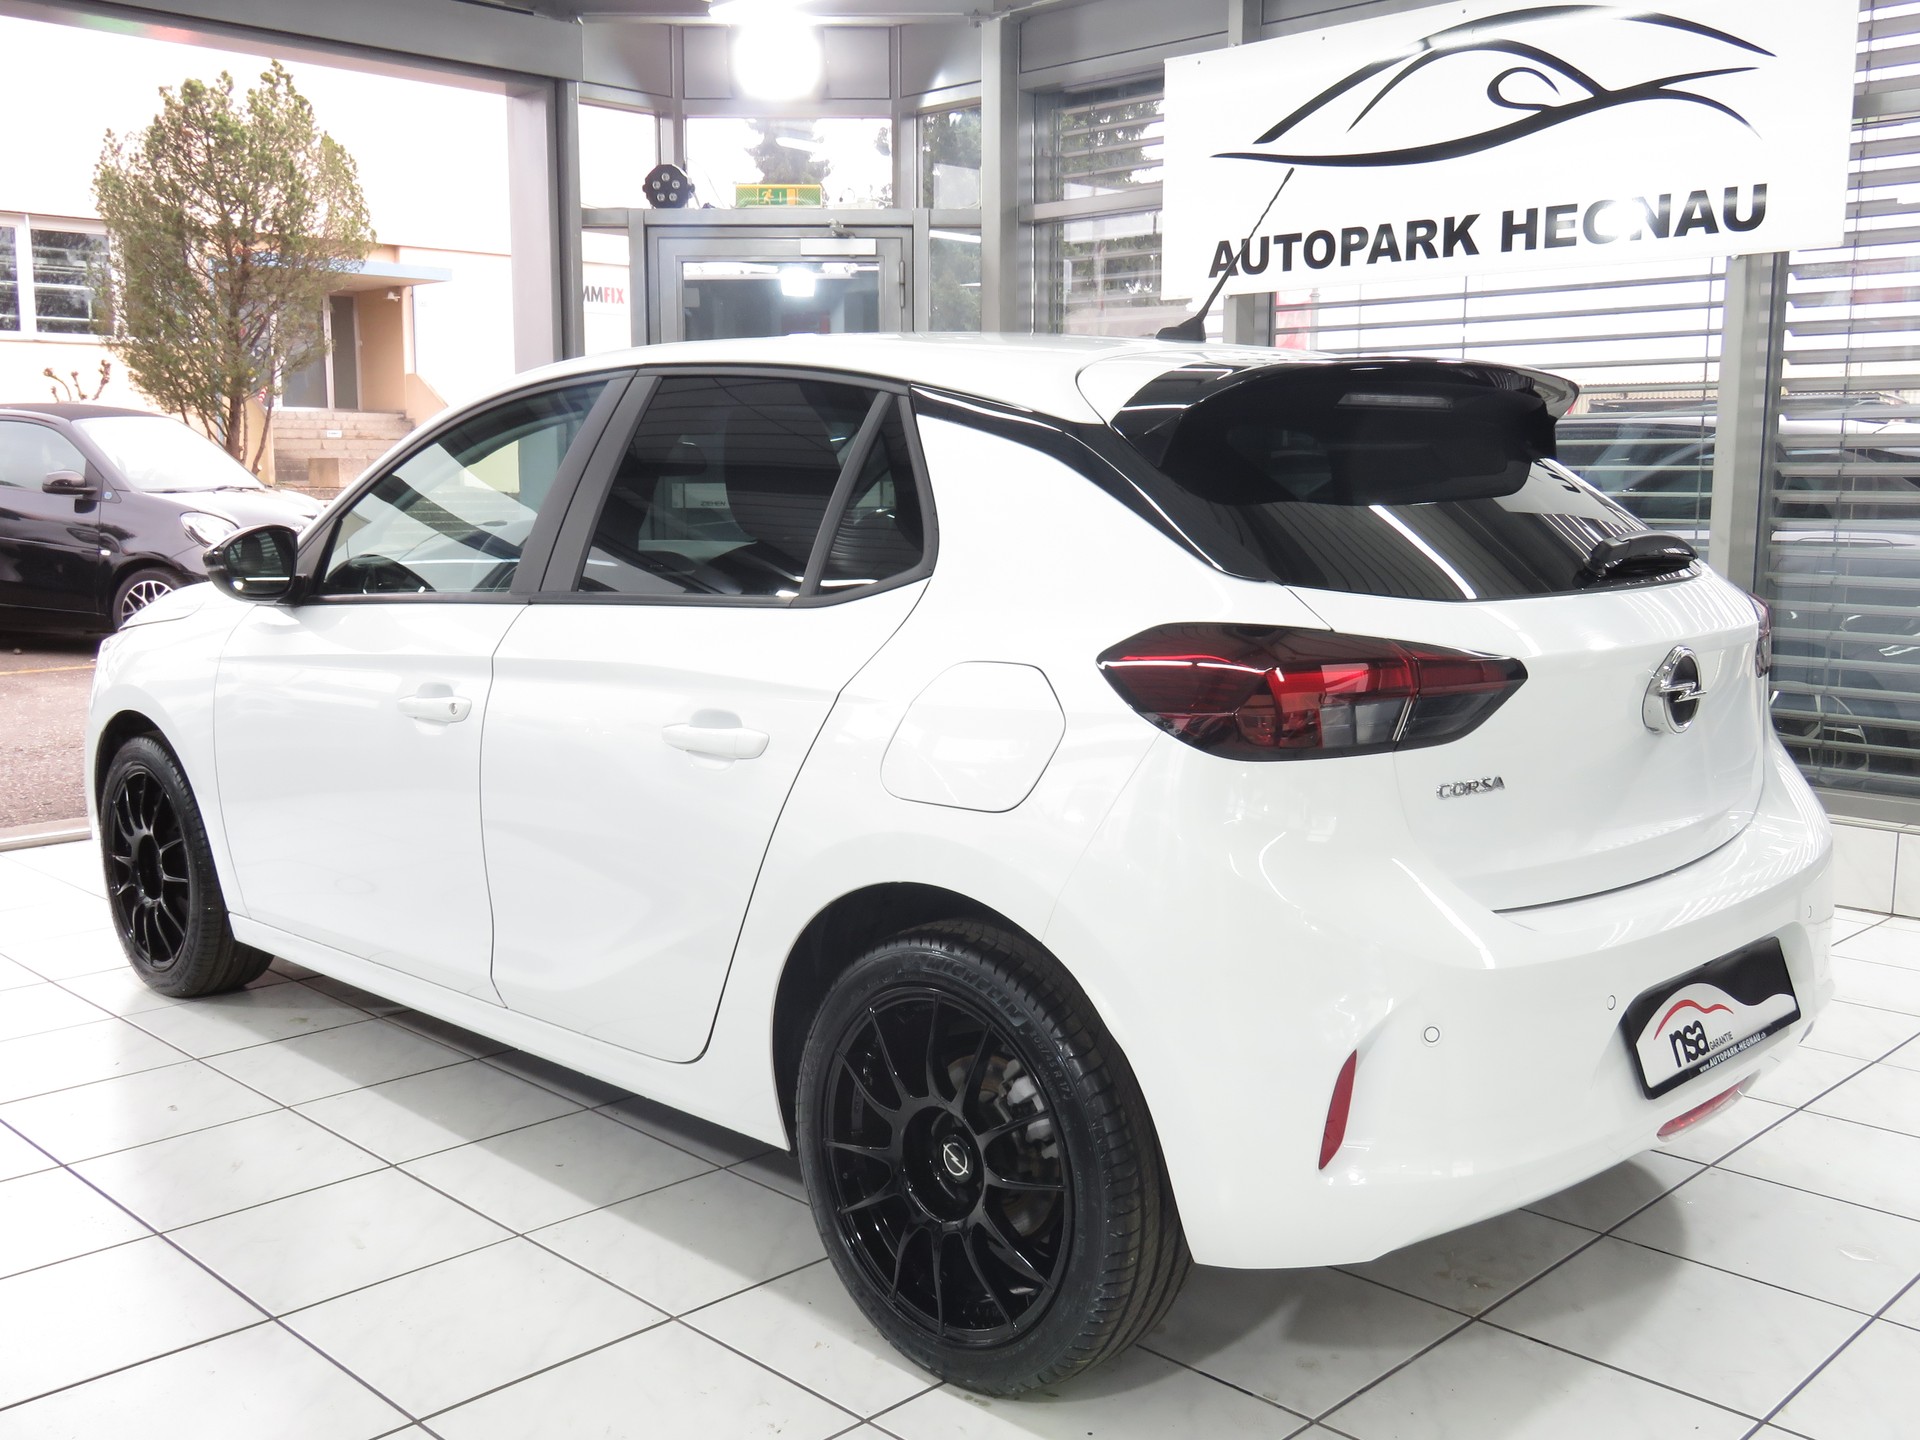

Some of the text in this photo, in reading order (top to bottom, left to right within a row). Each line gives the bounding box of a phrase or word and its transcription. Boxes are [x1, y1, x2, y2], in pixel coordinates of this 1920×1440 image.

[1208, 213, 1481, 278] AUTOPARK
[1436, 776, 1506, 800] CORSA
[1669, 1020, 1710, 1068] nsa
[1699, 1031, 1767, 1073] www.AUTOPARK-HEGNAU.ch
[1709, 1031, 1733, 1050] GARANTIE
